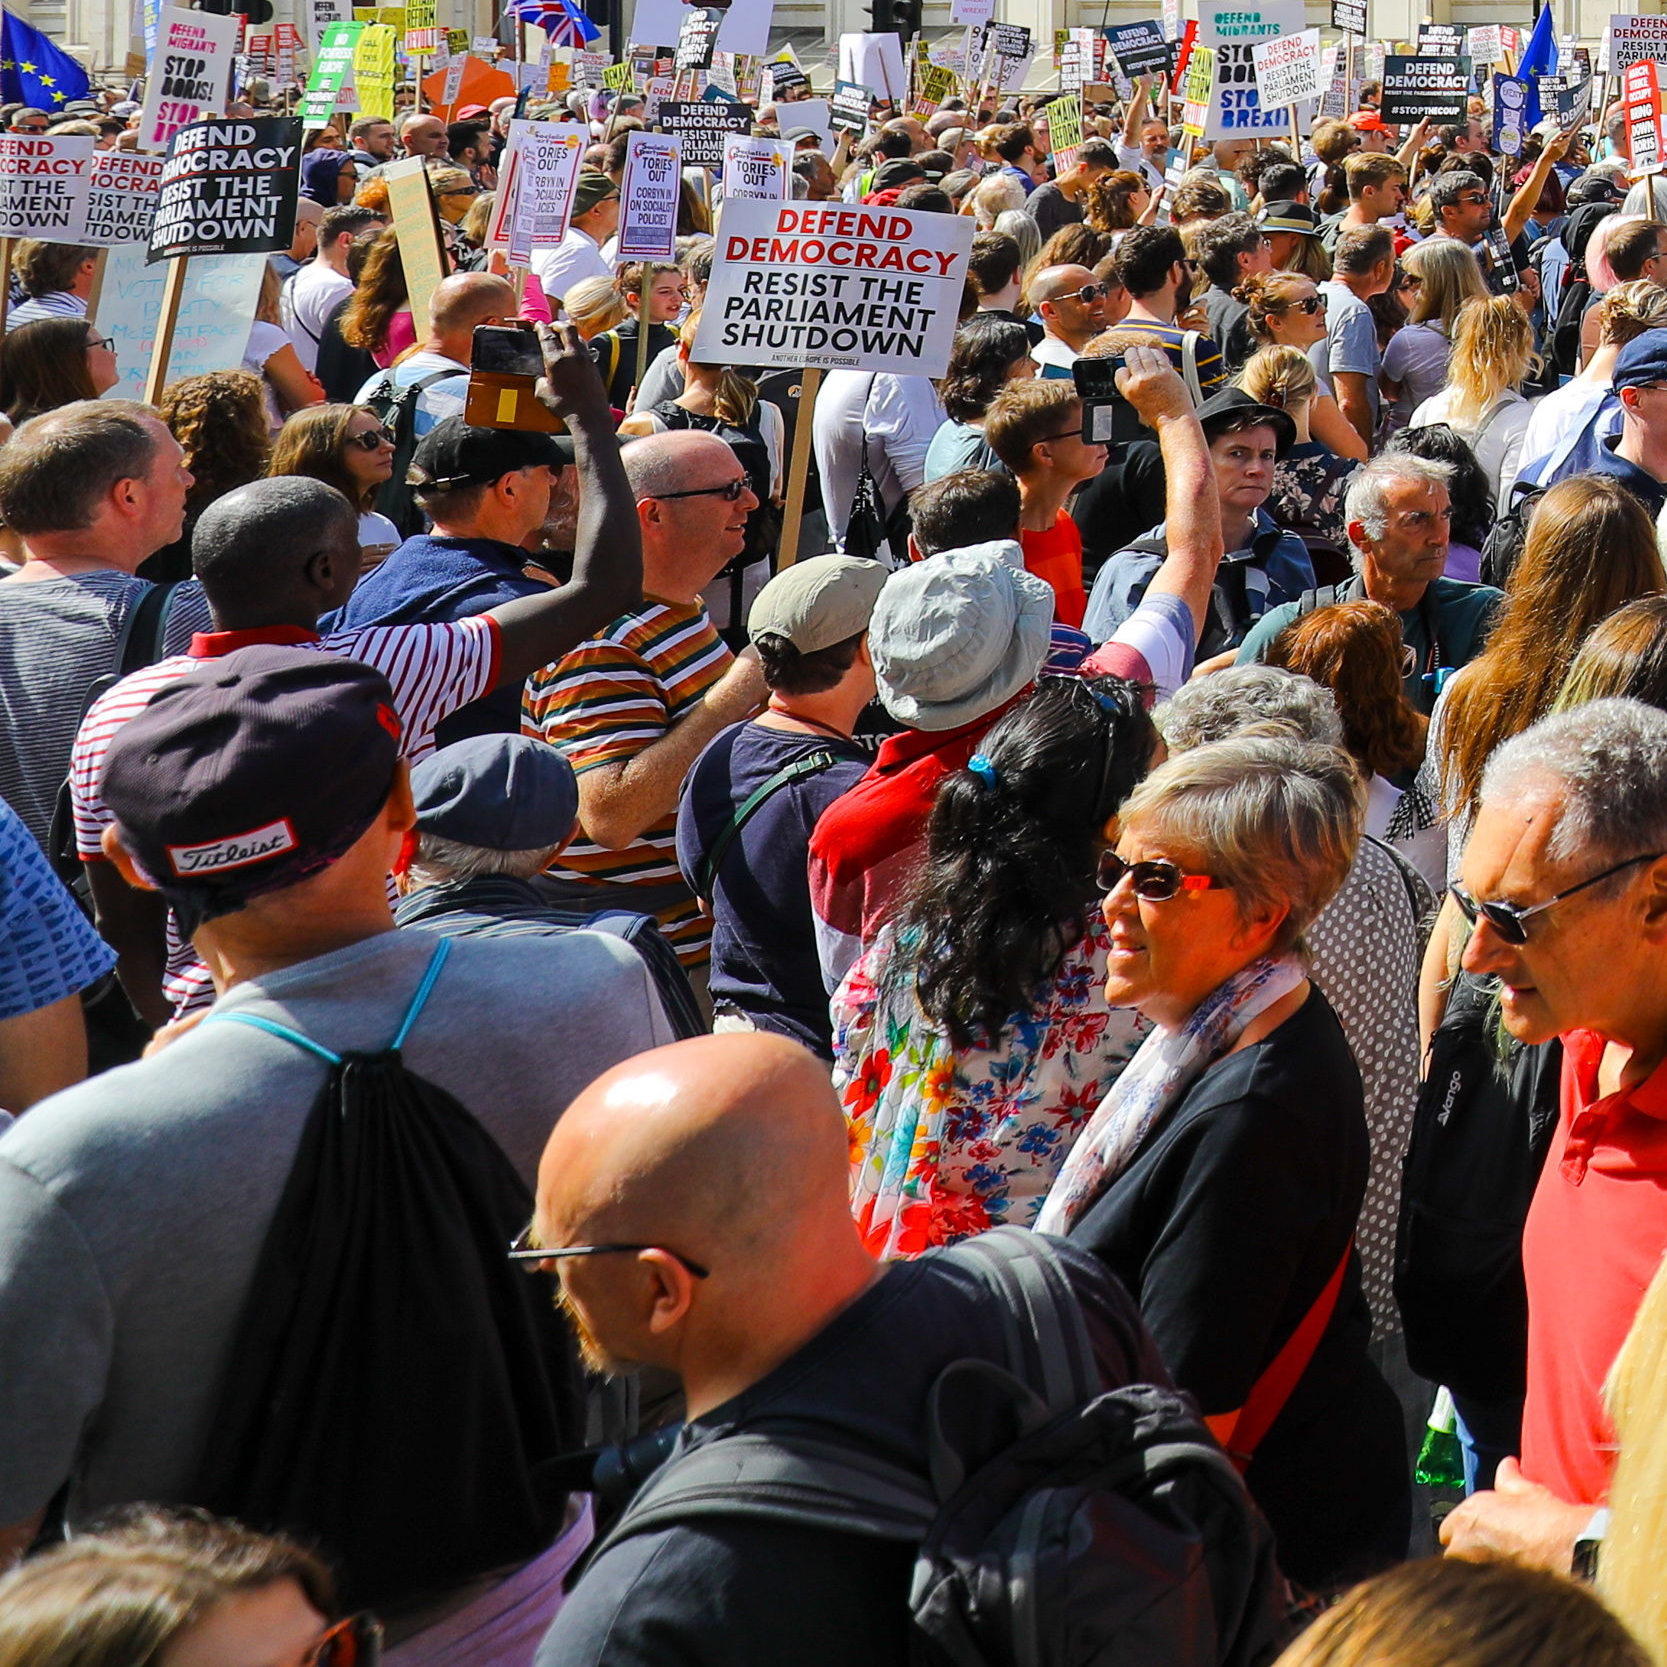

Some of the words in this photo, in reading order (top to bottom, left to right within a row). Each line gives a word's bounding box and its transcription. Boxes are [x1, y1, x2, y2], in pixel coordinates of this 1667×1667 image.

[1214, 12, 1261, 24] DEFEND
[169, 23, 206, 39] DEFEND
[167, 38, 217, 53] MIGRANTS
[1267, 36, 1302, 56] DEFEND
[1622, 42, 1660, 52] RESIST
[164, 55, 206, 78] STOP
[1257, 46, 1317, 71] DEMOCRACY
[1405, 62, 1455, 75] DEFEND
[160, 79, 214, 101] BORIS!
[1385, 75, 1469, 89] DEMOCRACY
[680, 104, 728, 116] DEFEND
[662, 116, 747, 129] DEMOCRACY
[174, 125, 256, 155] DEFEND
[161, 146, 295, 184] DEMOCRACY
[537, 159, 558, 171] OUT
[642, 156, 673, 171] TORIES
[736, 162, 777, 177] TORIES
[648, 170, 666, 183] OUT
[743, 174, 767, 187] OUT
[160, 180, 201, 206] RESIST
[219, 176, 270, 196] THE
[636, 187, 664, 198] CORBYN
[153, 196, 282, 230] PARLIAMENT
[630, 200, 641, 211] ON
[643, 200, 674, 213] SOCIALIST
[637, 213, 667, 225] POLICIES
[777, 209, 913, 240] DEFEND
[150, 217, 275, 251] SHUTDOWN
[725, 236, 959, 275] DEMOCRACY
[743, 272, 849, 298] RESIST
[854, 277, 924, 305] THE
[724, 297, 936, 332] PARLIAMENT
[722, 323, 924, 357] SHUTDOWN
[179, 834, 285, 871] Titleist
